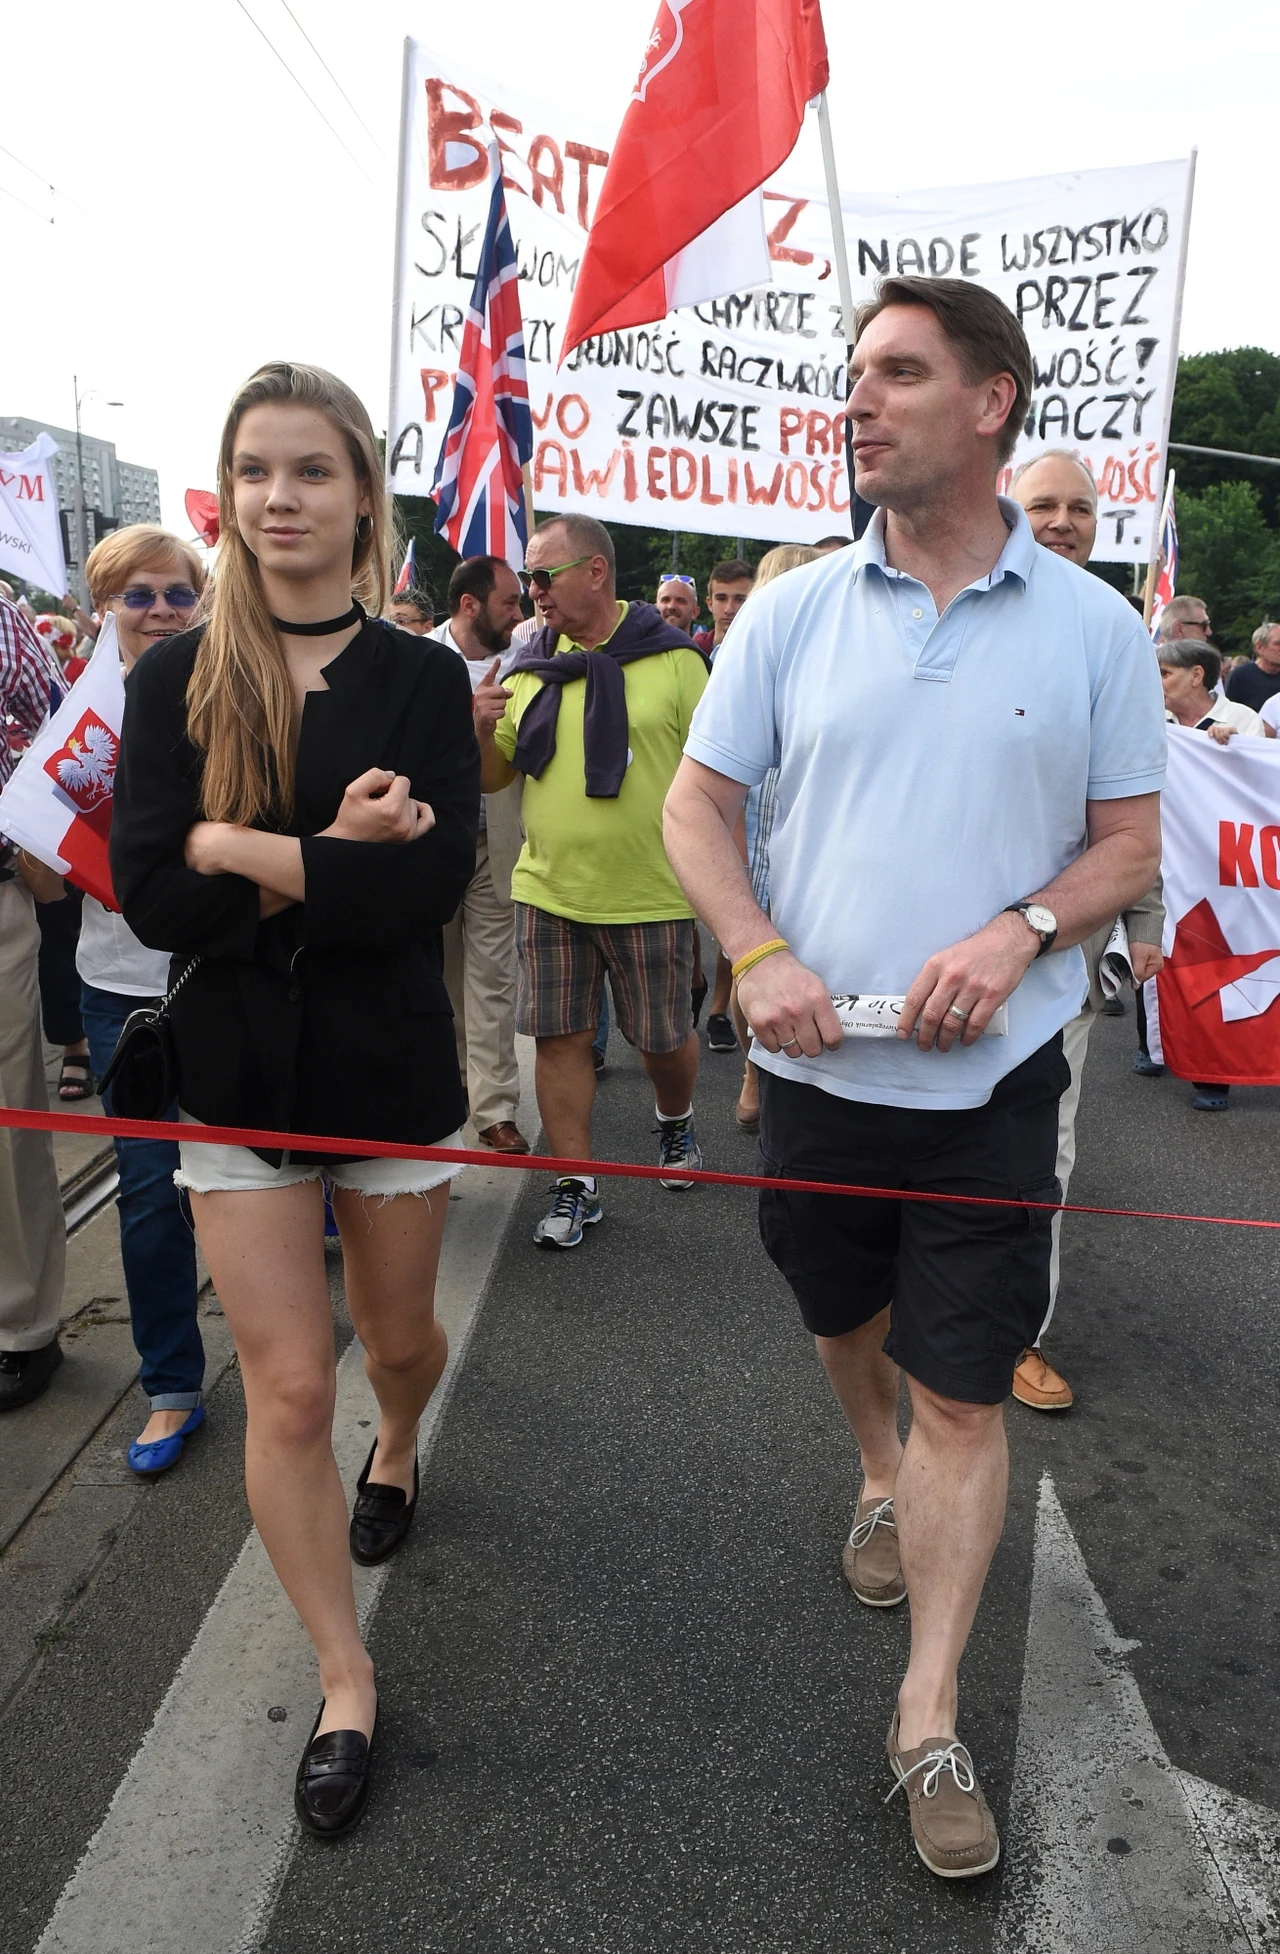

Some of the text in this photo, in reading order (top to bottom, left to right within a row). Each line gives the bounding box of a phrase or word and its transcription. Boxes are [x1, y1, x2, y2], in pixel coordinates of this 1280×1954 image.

[425, 78, 609, 233] BEAT
[858, 231, 981, 276] NADE
[1001, 206, 1169, 272] WSZYSTKO
[1016, 266, 1159, 331] PRZEZ
[1032, 336, 1160, 386] WOŚĆ!
[616, 389, 761, 452] ZAWSZE
[390, 422, 423, 476] A
[533, 436, 850, 514] AWIEDLIWOŚĆ
[0, 531, 32, 554] WSKI
[840, 1020, 854, 1029] Oby
